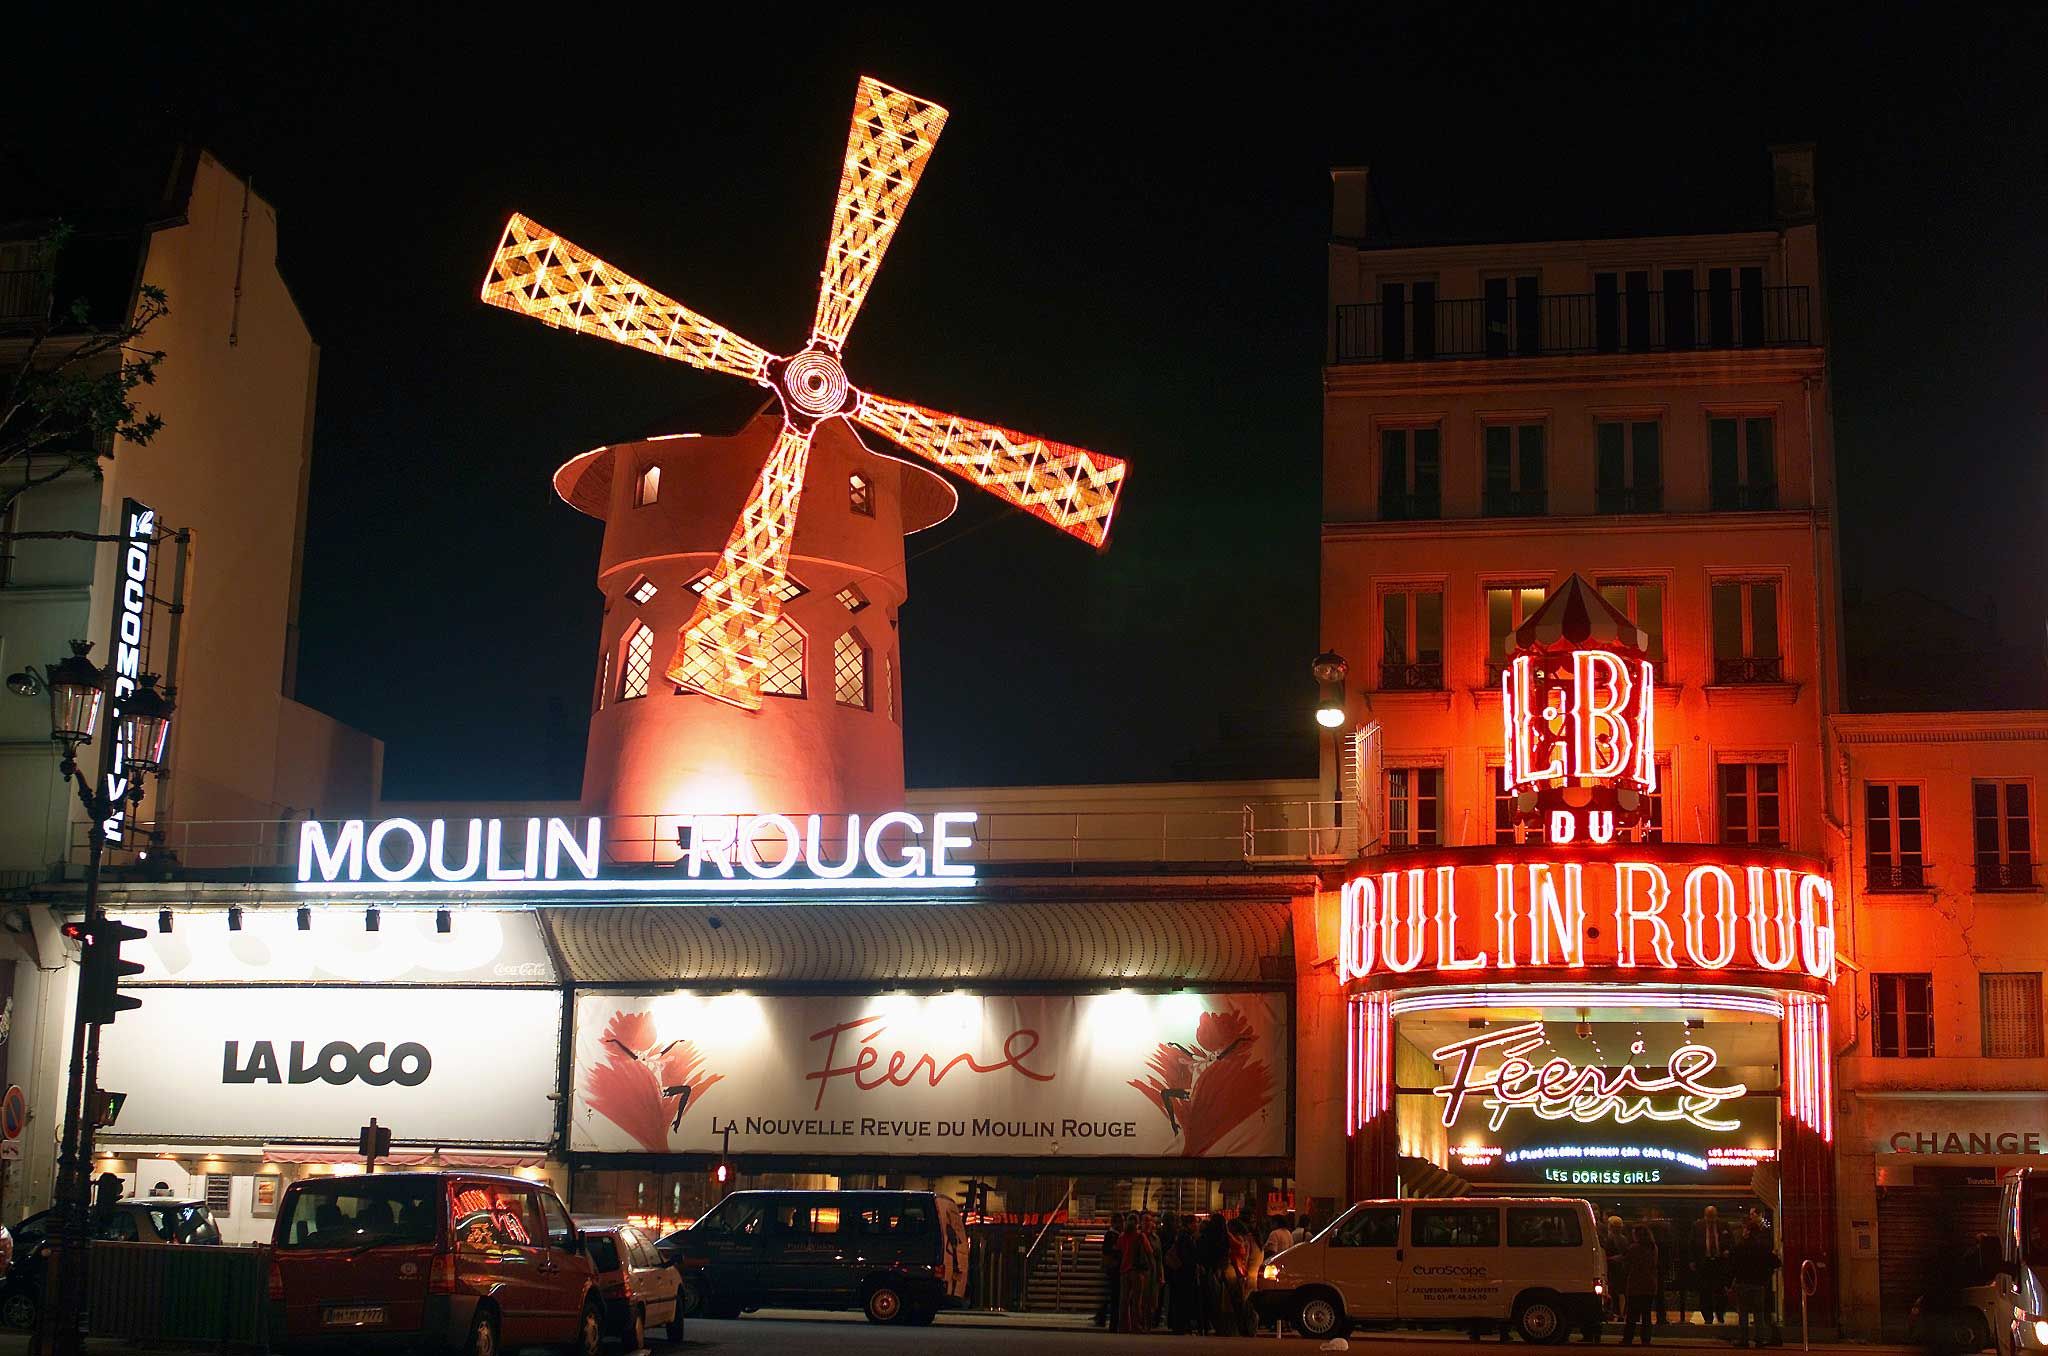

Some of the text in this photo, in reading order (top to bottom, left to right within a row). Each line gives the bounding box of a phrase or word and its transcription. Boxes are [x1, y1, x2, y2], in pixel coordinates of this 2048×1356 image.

[298, 812, 978, 882] MOULIN ROUGE
[1551, 811, 1614, 844] DU
[1340, 862, 1836, 986] OULIN ROUG
[222, 1040, 432, 1087] LA LOCO
[1433, 1022, 1747, 1129] Féerie
[712, 1116, 739, 1135] LA
[745, 1116, 854, 1136] NOUVELLE
[860, 1117, 931, 1137] REVUE
[972, 1118, 1055, 1137] MOULIN
[1062, 1119, 1136, 1138] ROUGE
[1889, 1131, 2041, 1155] CHANGE
[1545, 1168, 1661, 1184] LES DORISS GIRLS
